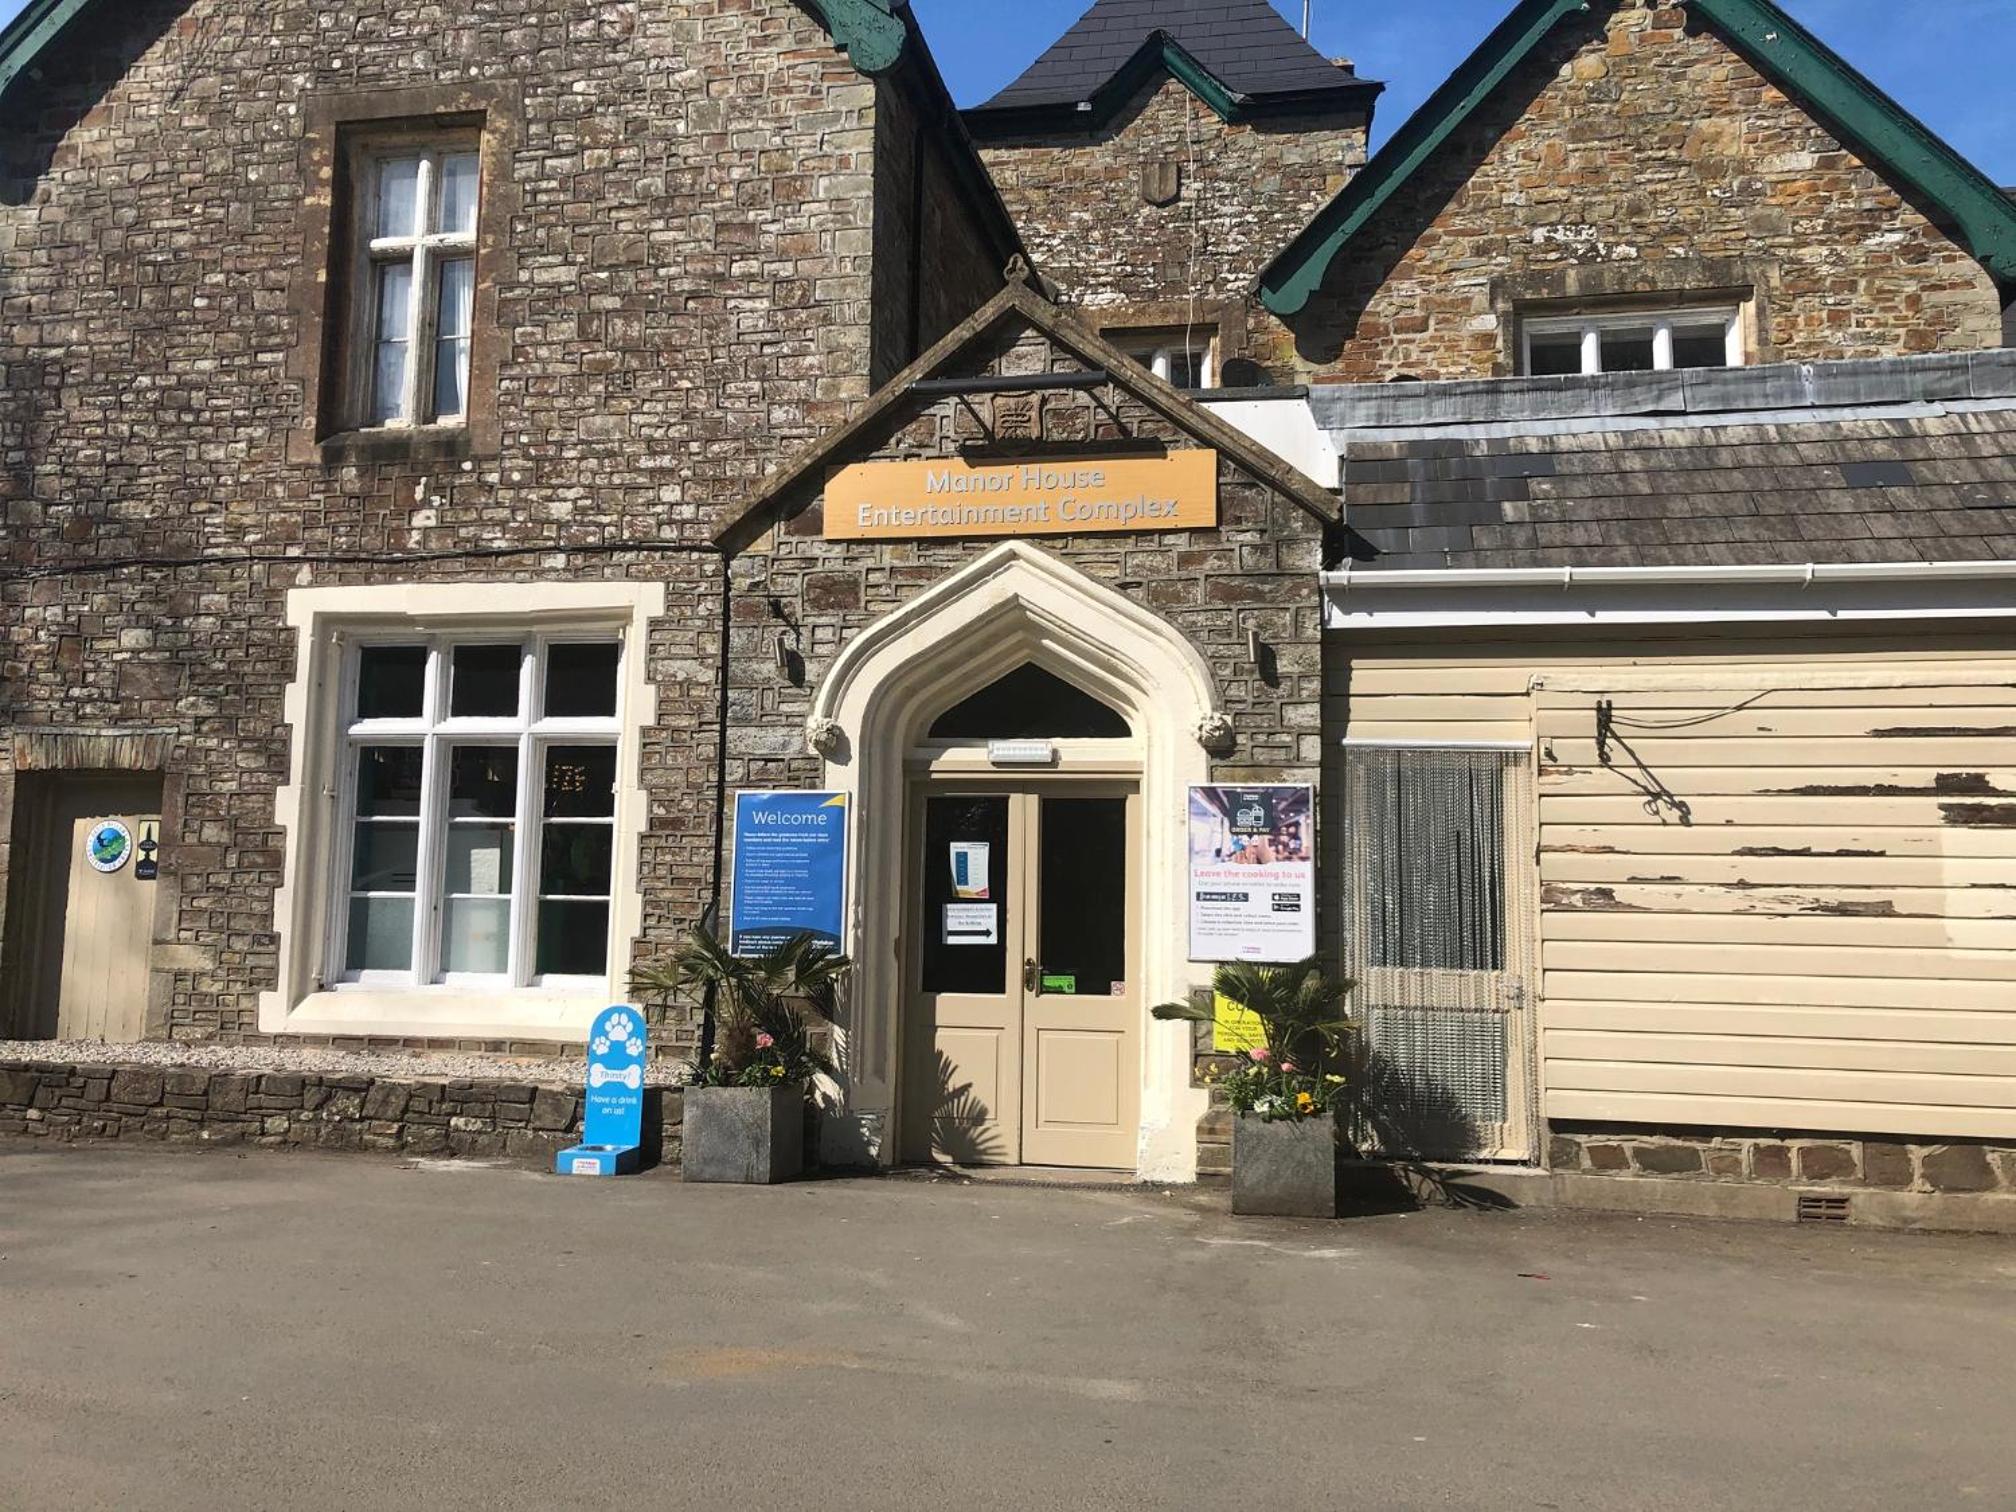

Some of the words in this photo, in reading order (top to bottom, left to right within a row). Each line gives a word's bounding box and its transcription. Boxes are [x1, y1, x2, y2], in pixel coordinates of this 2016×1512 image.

[925, 467, 1015, 494] Manor
[1022, 465, 1106, 491] House
[858, 500, 1049, 528] Entertainment
[1056, 494, 1180, 525] Complex
[752, 811, 828, 825] Welcome
[1194, 870, 1221, 878] Leave
[1224, 870, 1240, 878] the
[1242, 871, 1279, 880] cooking
[591, 1095, 610, 1104] Have
[610, 1096, 617, 1104] a
[617, 1095, 638, 1105] drink
[601, 1107, 613, 1115] on
